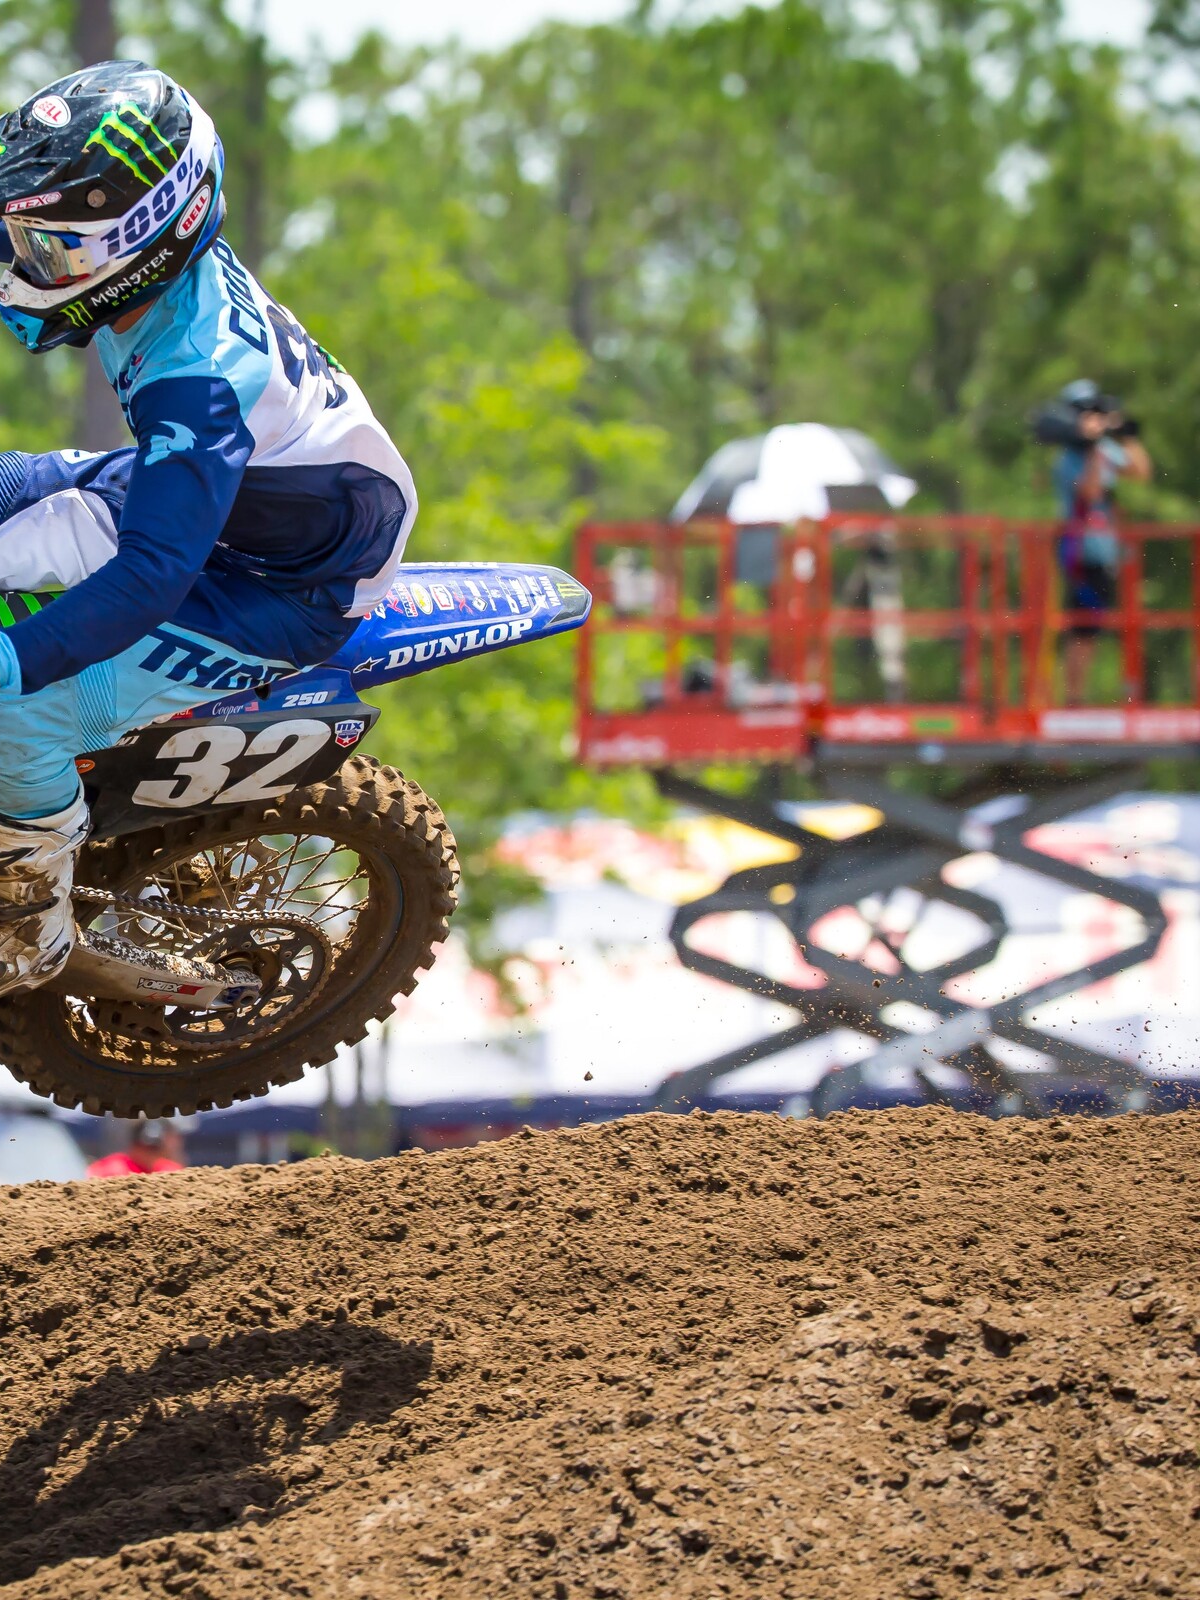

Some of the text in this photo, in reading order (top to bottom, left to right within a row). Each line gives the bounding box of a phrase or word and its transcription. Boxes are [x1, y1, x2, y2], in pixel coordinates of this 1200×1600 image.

[100, 147, 204, 257] 100%
[181, 195, 208, 232] BELL
[89, 247, 174, 307] MONSTER
[111, 265, 167, 307] ENERGY
[210, 234, 269, 356] COOP
[384, 618, 533, 670] DUNLOP
[211, 701, 244, 722] Cooper
[131, 718, 332, 808] 32
[136, 976, 183, 993] VORTEX
